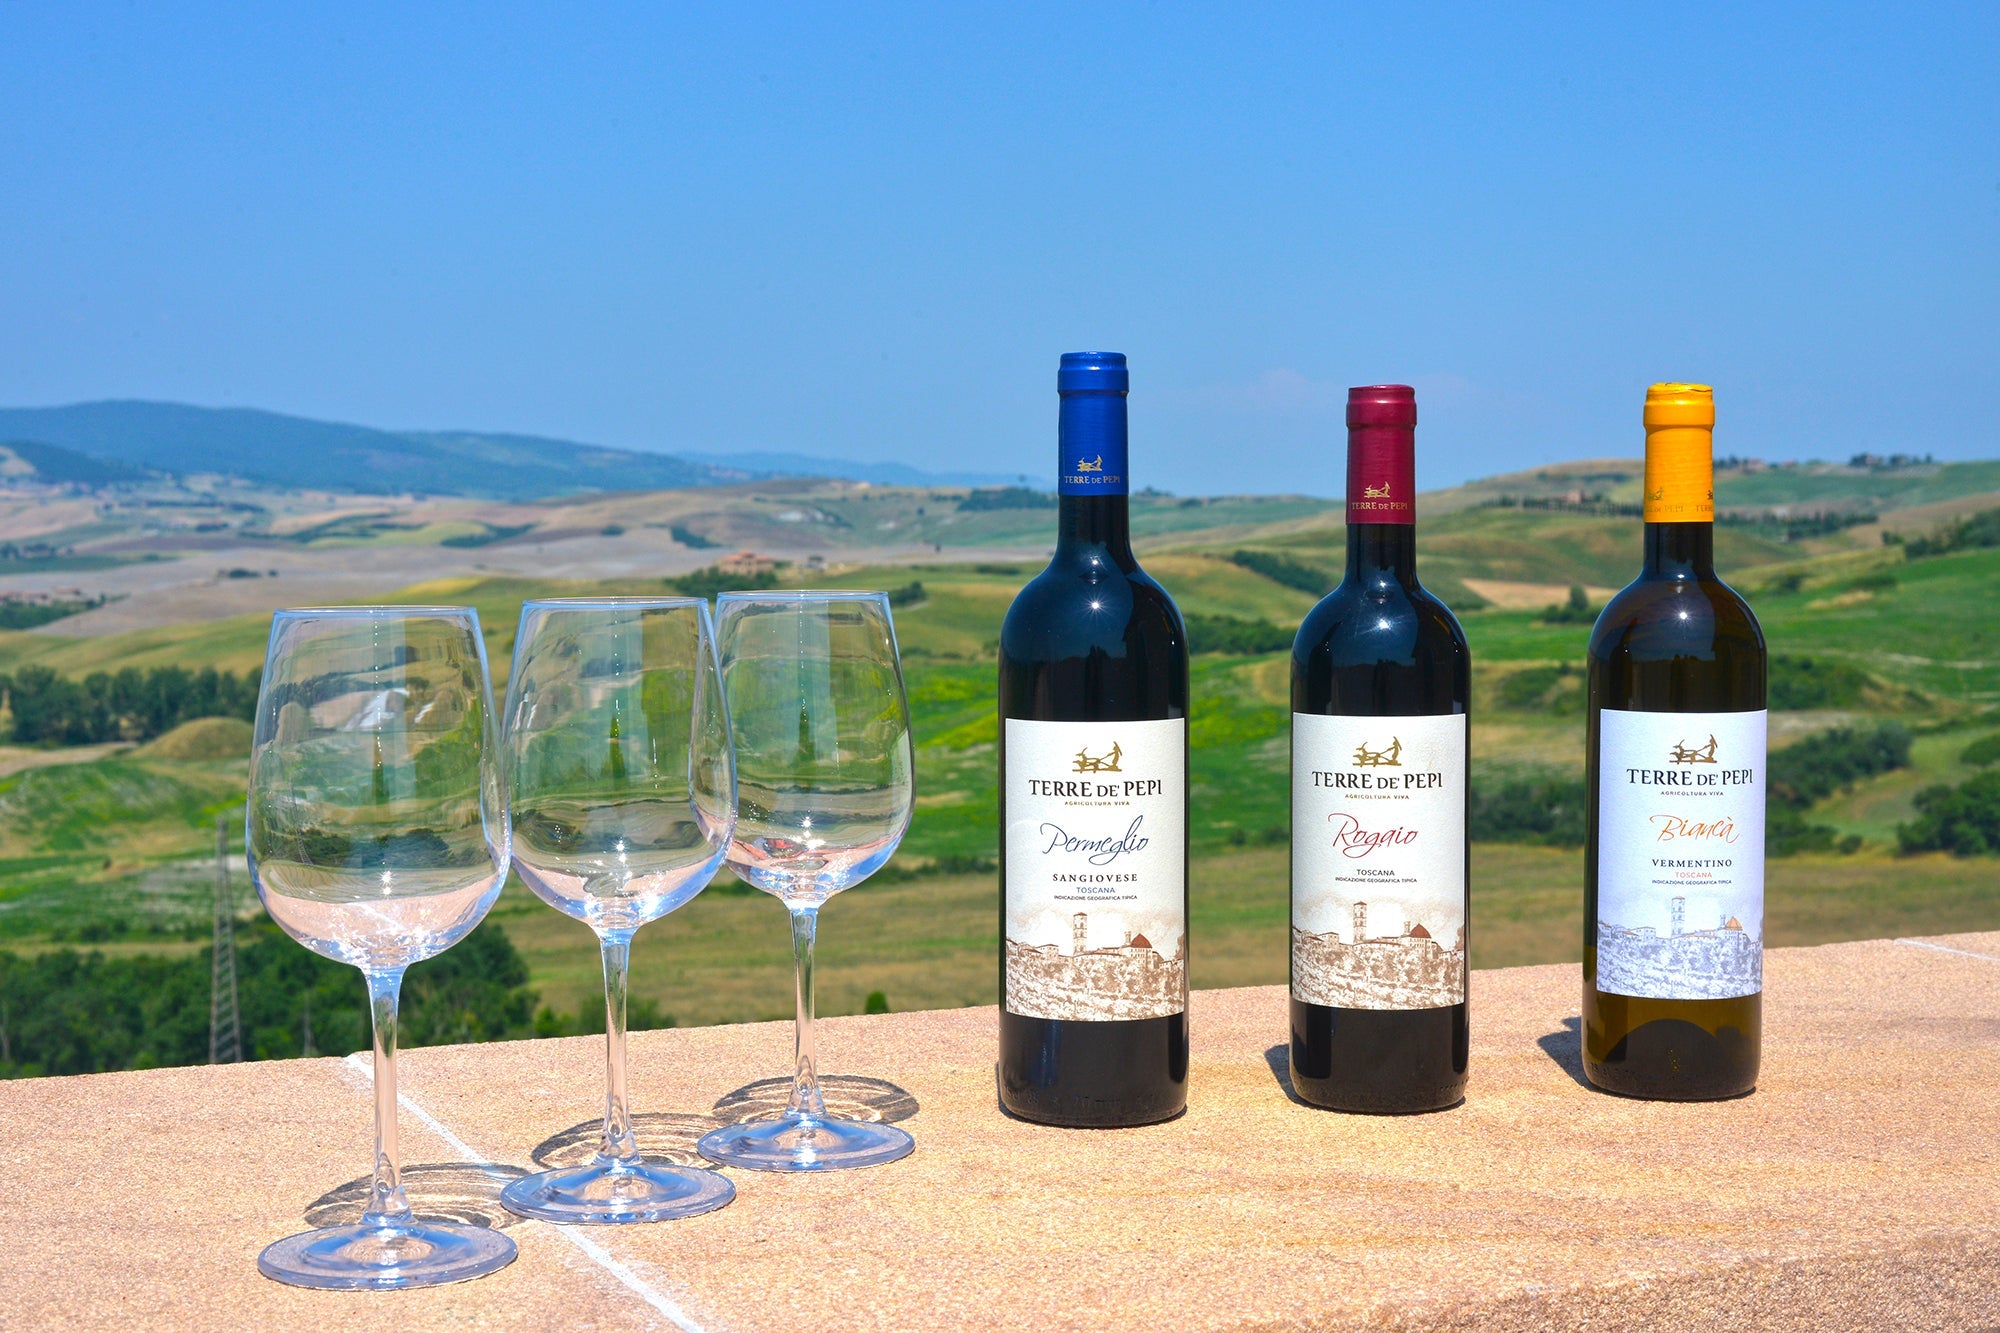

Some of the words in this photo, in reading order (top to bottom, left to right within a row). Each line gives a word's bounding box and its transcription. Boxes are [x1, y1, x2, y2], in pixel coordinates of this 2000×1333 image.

[1064, 476, 1090, 484] TERRE
[1312, 771, 1373, 789] TERRE
[1404, 772, 1443, 789] PEPI
[1627, 768, 1693, 786] TERRE
[1722, 768, 1753, 786] PEPI
[1028, 779, 1093, 797] TERRE
[1123, 779, 1163, 796] PEPI
[1327, 812, 1419, 859] Rogaio
[1649, 814, 1740, 844] Biancà
[1039, 814, 1149, 866] Permeglio
[1651, 858, 1733, 868] VERMENTINO
[1052, 873, 1138, 883] SANGIOVESE
